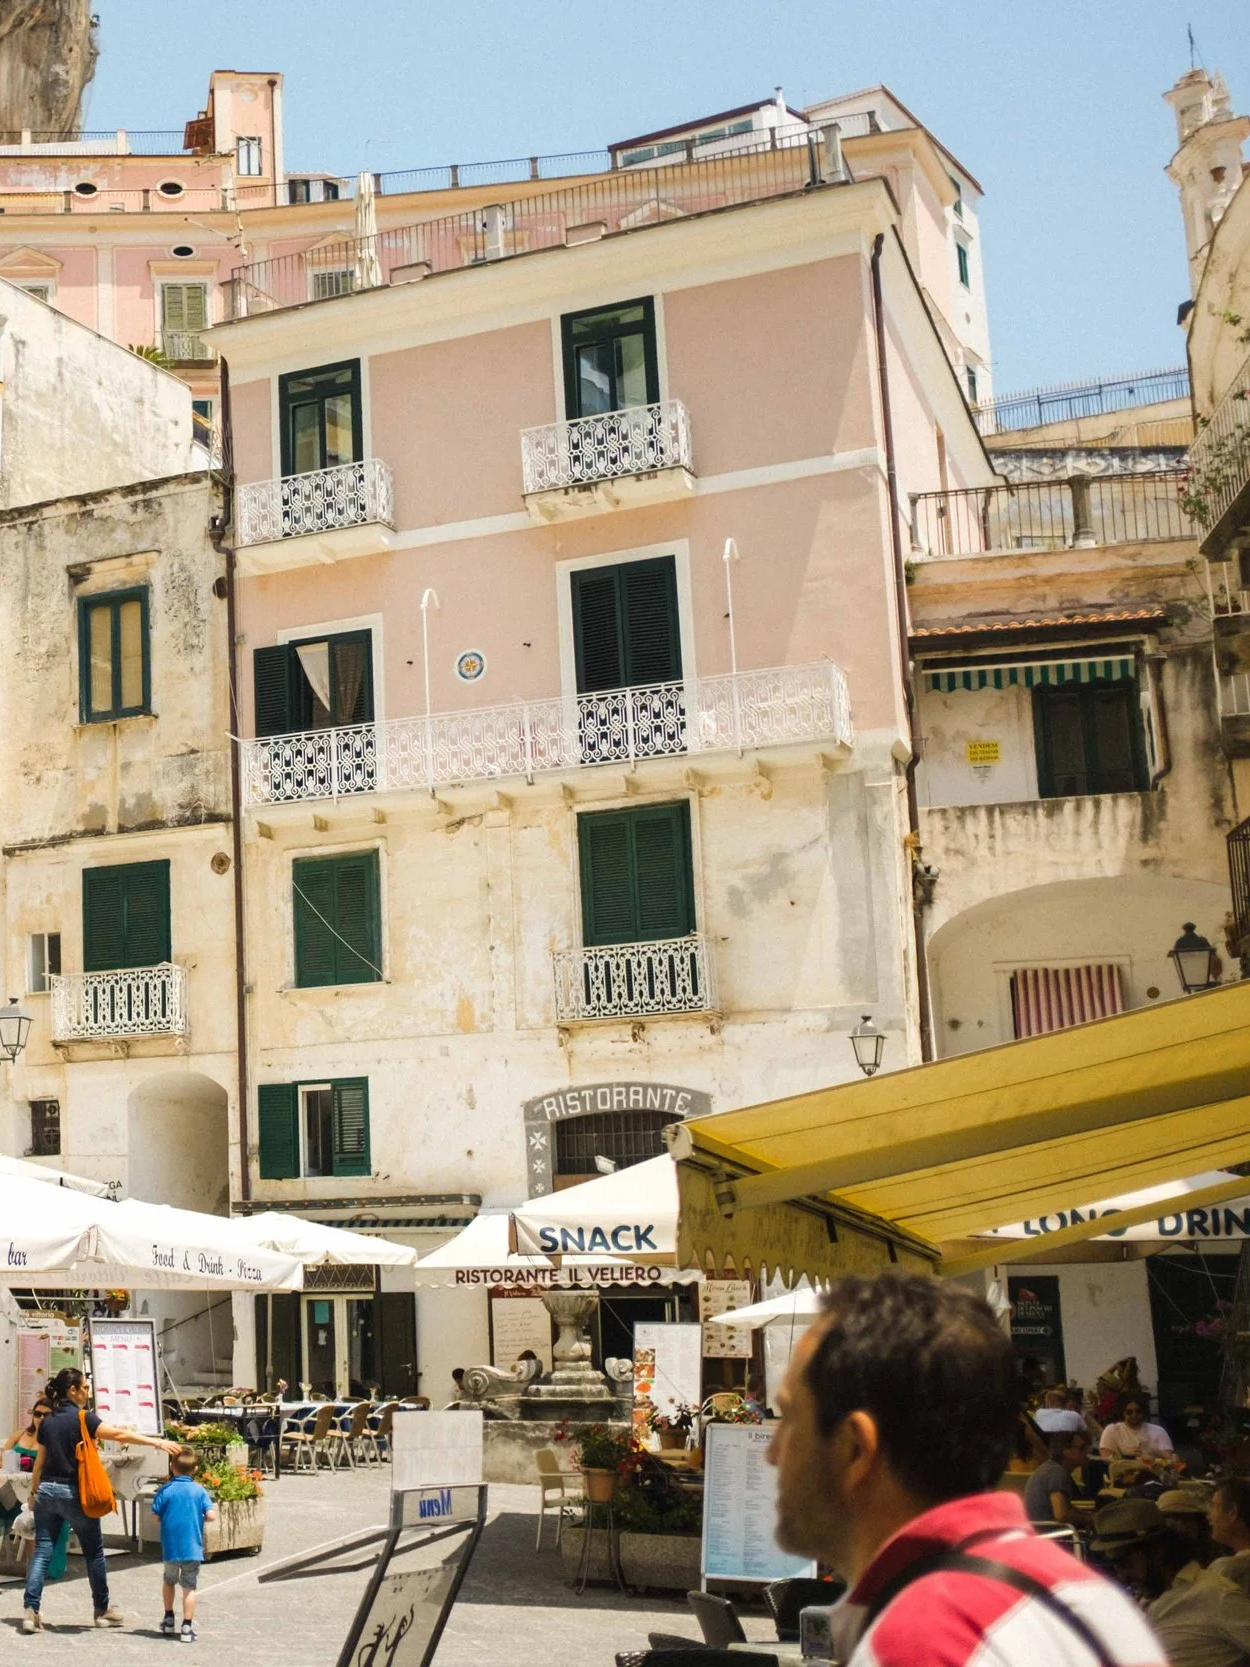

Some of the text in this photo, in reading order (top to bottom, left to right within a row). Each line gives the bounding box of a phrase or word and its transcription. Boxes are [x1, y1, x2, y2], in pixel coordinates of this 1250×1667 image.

[543, 1087, 692, 1120] RISTORANTE
[540, 1225, 658, 1253] SNACK
[7, 1242, 28, 1267] bar
[152, 1245, 174, 1268] Food
[183, 1250, 191, 1271] &
[198, 1252, 224, 1276] Drink
[237, 1258, 262, 1281] Pizza
[456, 1265, 662, 1285] RISTORANTE IL VELIERO
[32, 1310, 55, 1318] vittoria
